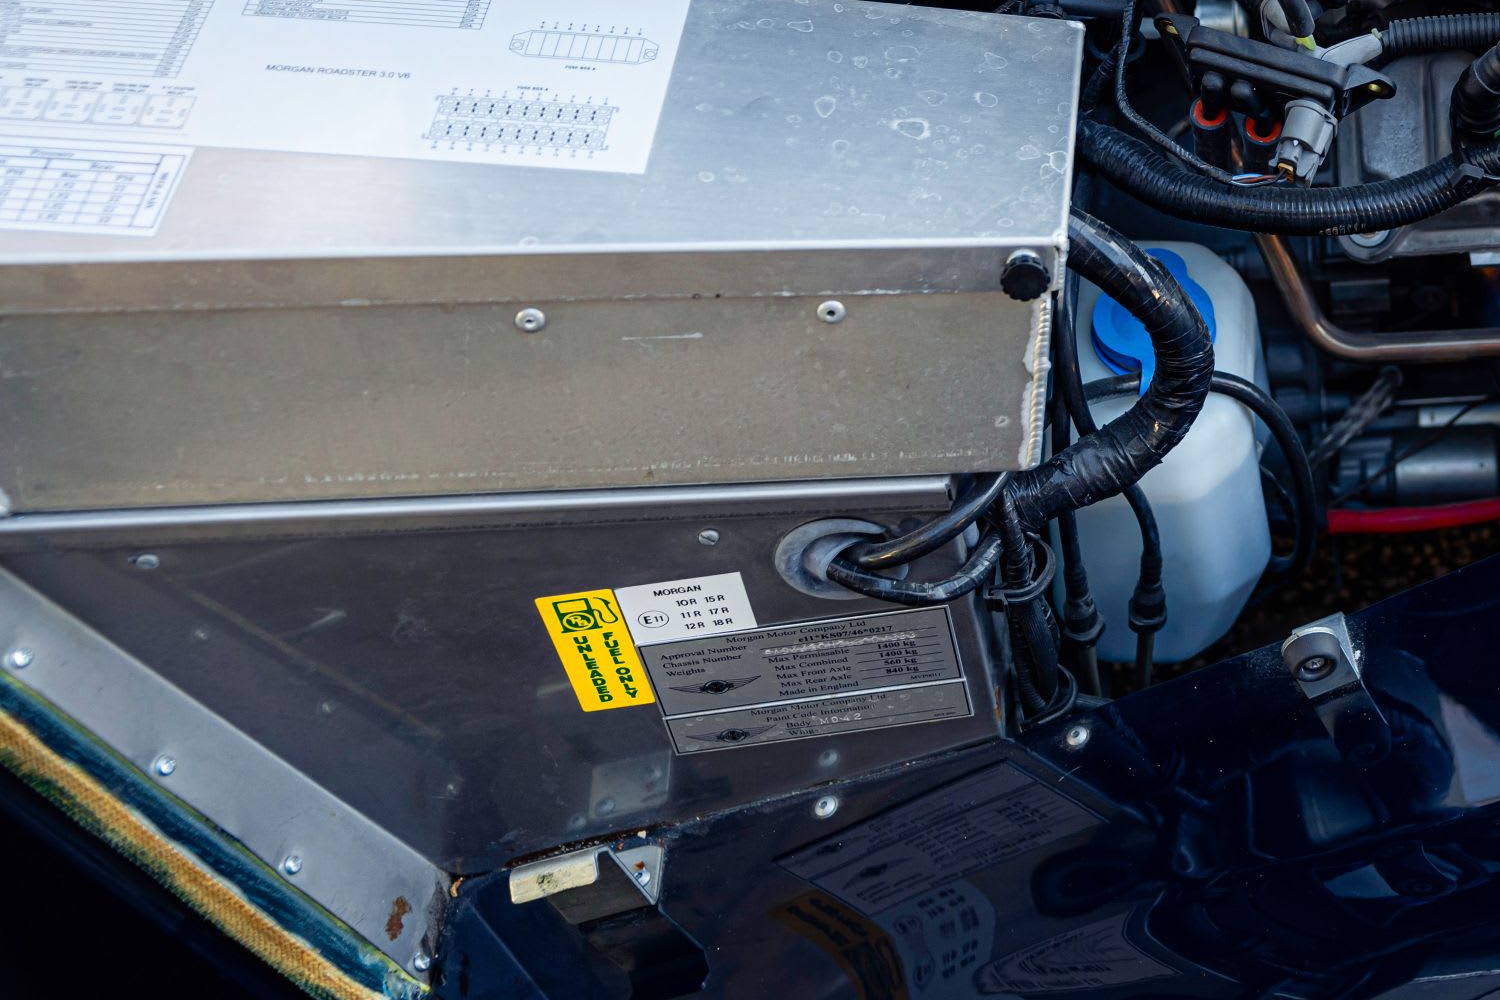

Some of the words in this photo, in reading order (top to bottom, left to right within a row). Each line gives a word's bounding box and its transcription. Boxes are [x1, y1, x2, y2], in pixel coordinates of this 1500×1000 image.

[265, 64, 314, 73] MORGAN
[317, 67, 377, 77] ROADSTER
[653, 584, 702, 597] MORGAN
[726, 633, 764, 644] Morgan
[767, 630, 797, 639] Motor
[800, 623, 846, 634] Company
[849, 620, 866, 628] Ltd
[660, 650, 705, 661] Approval
[708, 645, 748, 655] Number
[663, 660, 700, 669] Chassis
[703, 654, 742, 664] Number
[768, 656, 789, 664] Max
[793, 648, 850, 661] Permissable
[878, 642, 900, 650] 1400
[902, 640, 916, 648] kg
[775, 663, 796, 672] Max
[799, 656, 848, 668] Combined
[880, 650, 902, 658] 1400
[905, 648, 918, 656] kg
[573, 636, 613, 703] UNLEADED
[602, 632, 624, 665] FUEL
[616, 667, 638, 698] ONLY
[666, 668, 706, 677] Weights
[776, 671, 798, 680] Max
[801, 668, 827, 677] Front
[830, 664, 851, 673] Axle
[904, 657, 918, 665] kg
[781, 680, 802, 688] Max
[806, 676, 826, 685] Rear
[830, 673, 852, 682] Axle
[886, 666, 904, 674] 840
[906, 666, 919, 674] kg
[780, 688, 806, 697] Made
[820, 680, 859, 692] England
[750, 706, 788, 717] Morgan
[790, 702, 819, 711] Motor
[822, 698, 867, 709] Company
[766, 714, 790, 722] Paint
